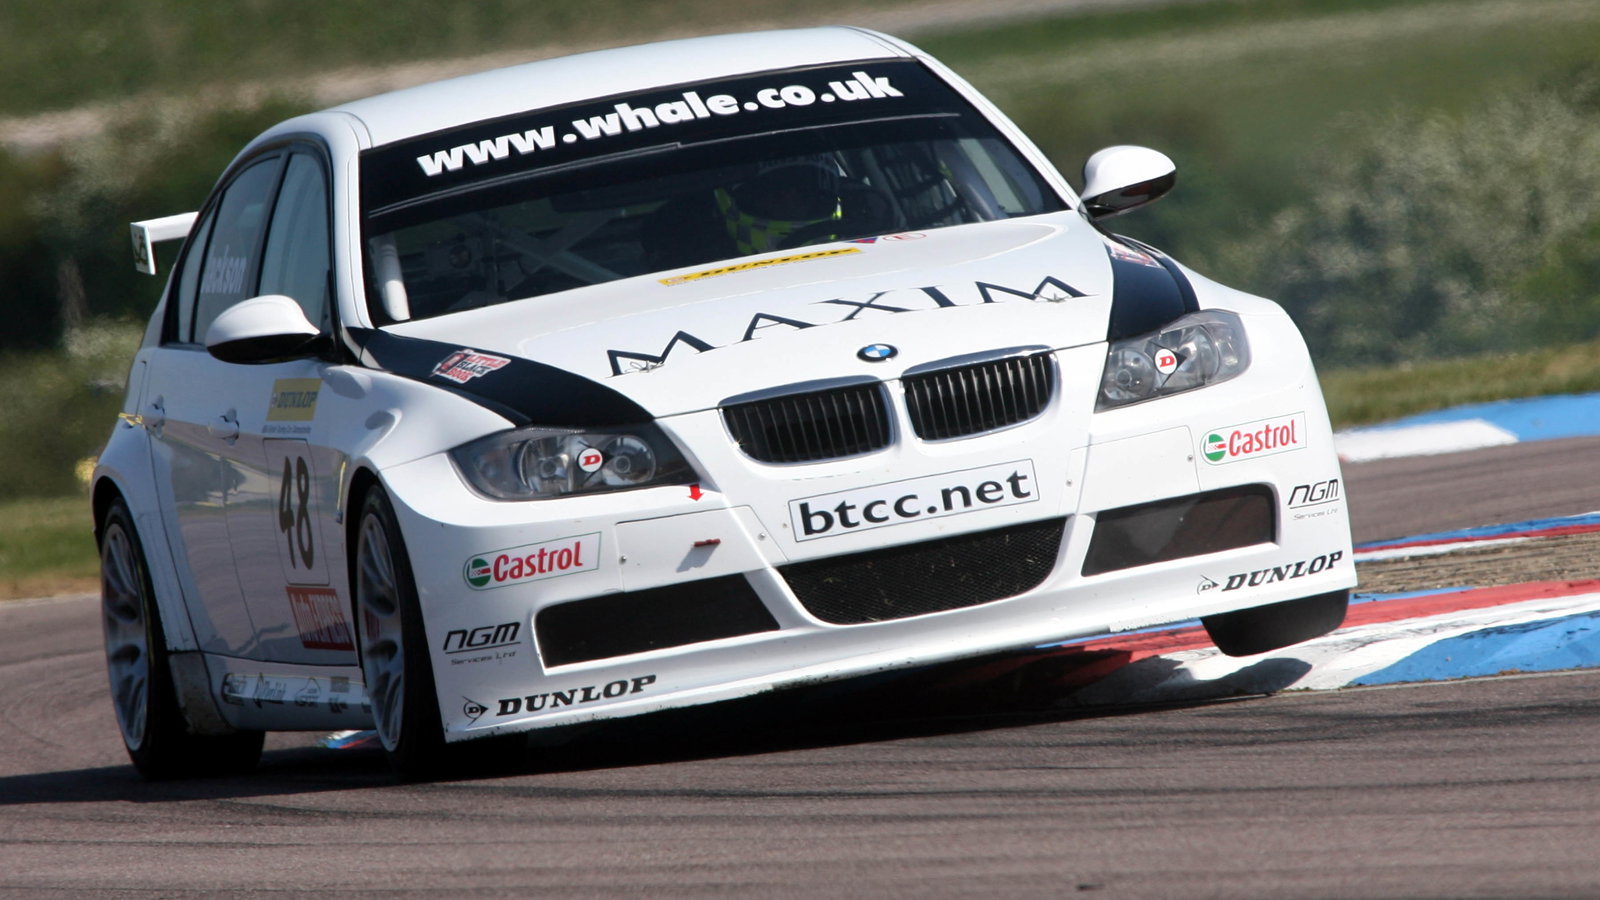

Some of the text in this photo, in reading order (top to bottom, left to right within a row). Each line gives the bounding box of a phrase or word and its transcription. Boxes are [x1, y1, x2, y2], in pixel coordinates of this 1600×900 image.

[416, 71, 904, 177] www.whale.co.uk
[699, 248, 860, 277] DUNLOP
[604, 275, 1099, 378] MAXIM
[1159, 355, 1175, 368] D
[1228, 419, 1298, 457] Castrol
[583, 454, 602, 467] D
[279, 455, 315, 571] 48
[799, 470, 1031, 536] btcc.net
[493, 541, 583, 583] Castrol
[1221, 550, 1344, 592] DUNLOP
[496, 674, 657, 717] DUNLOP
